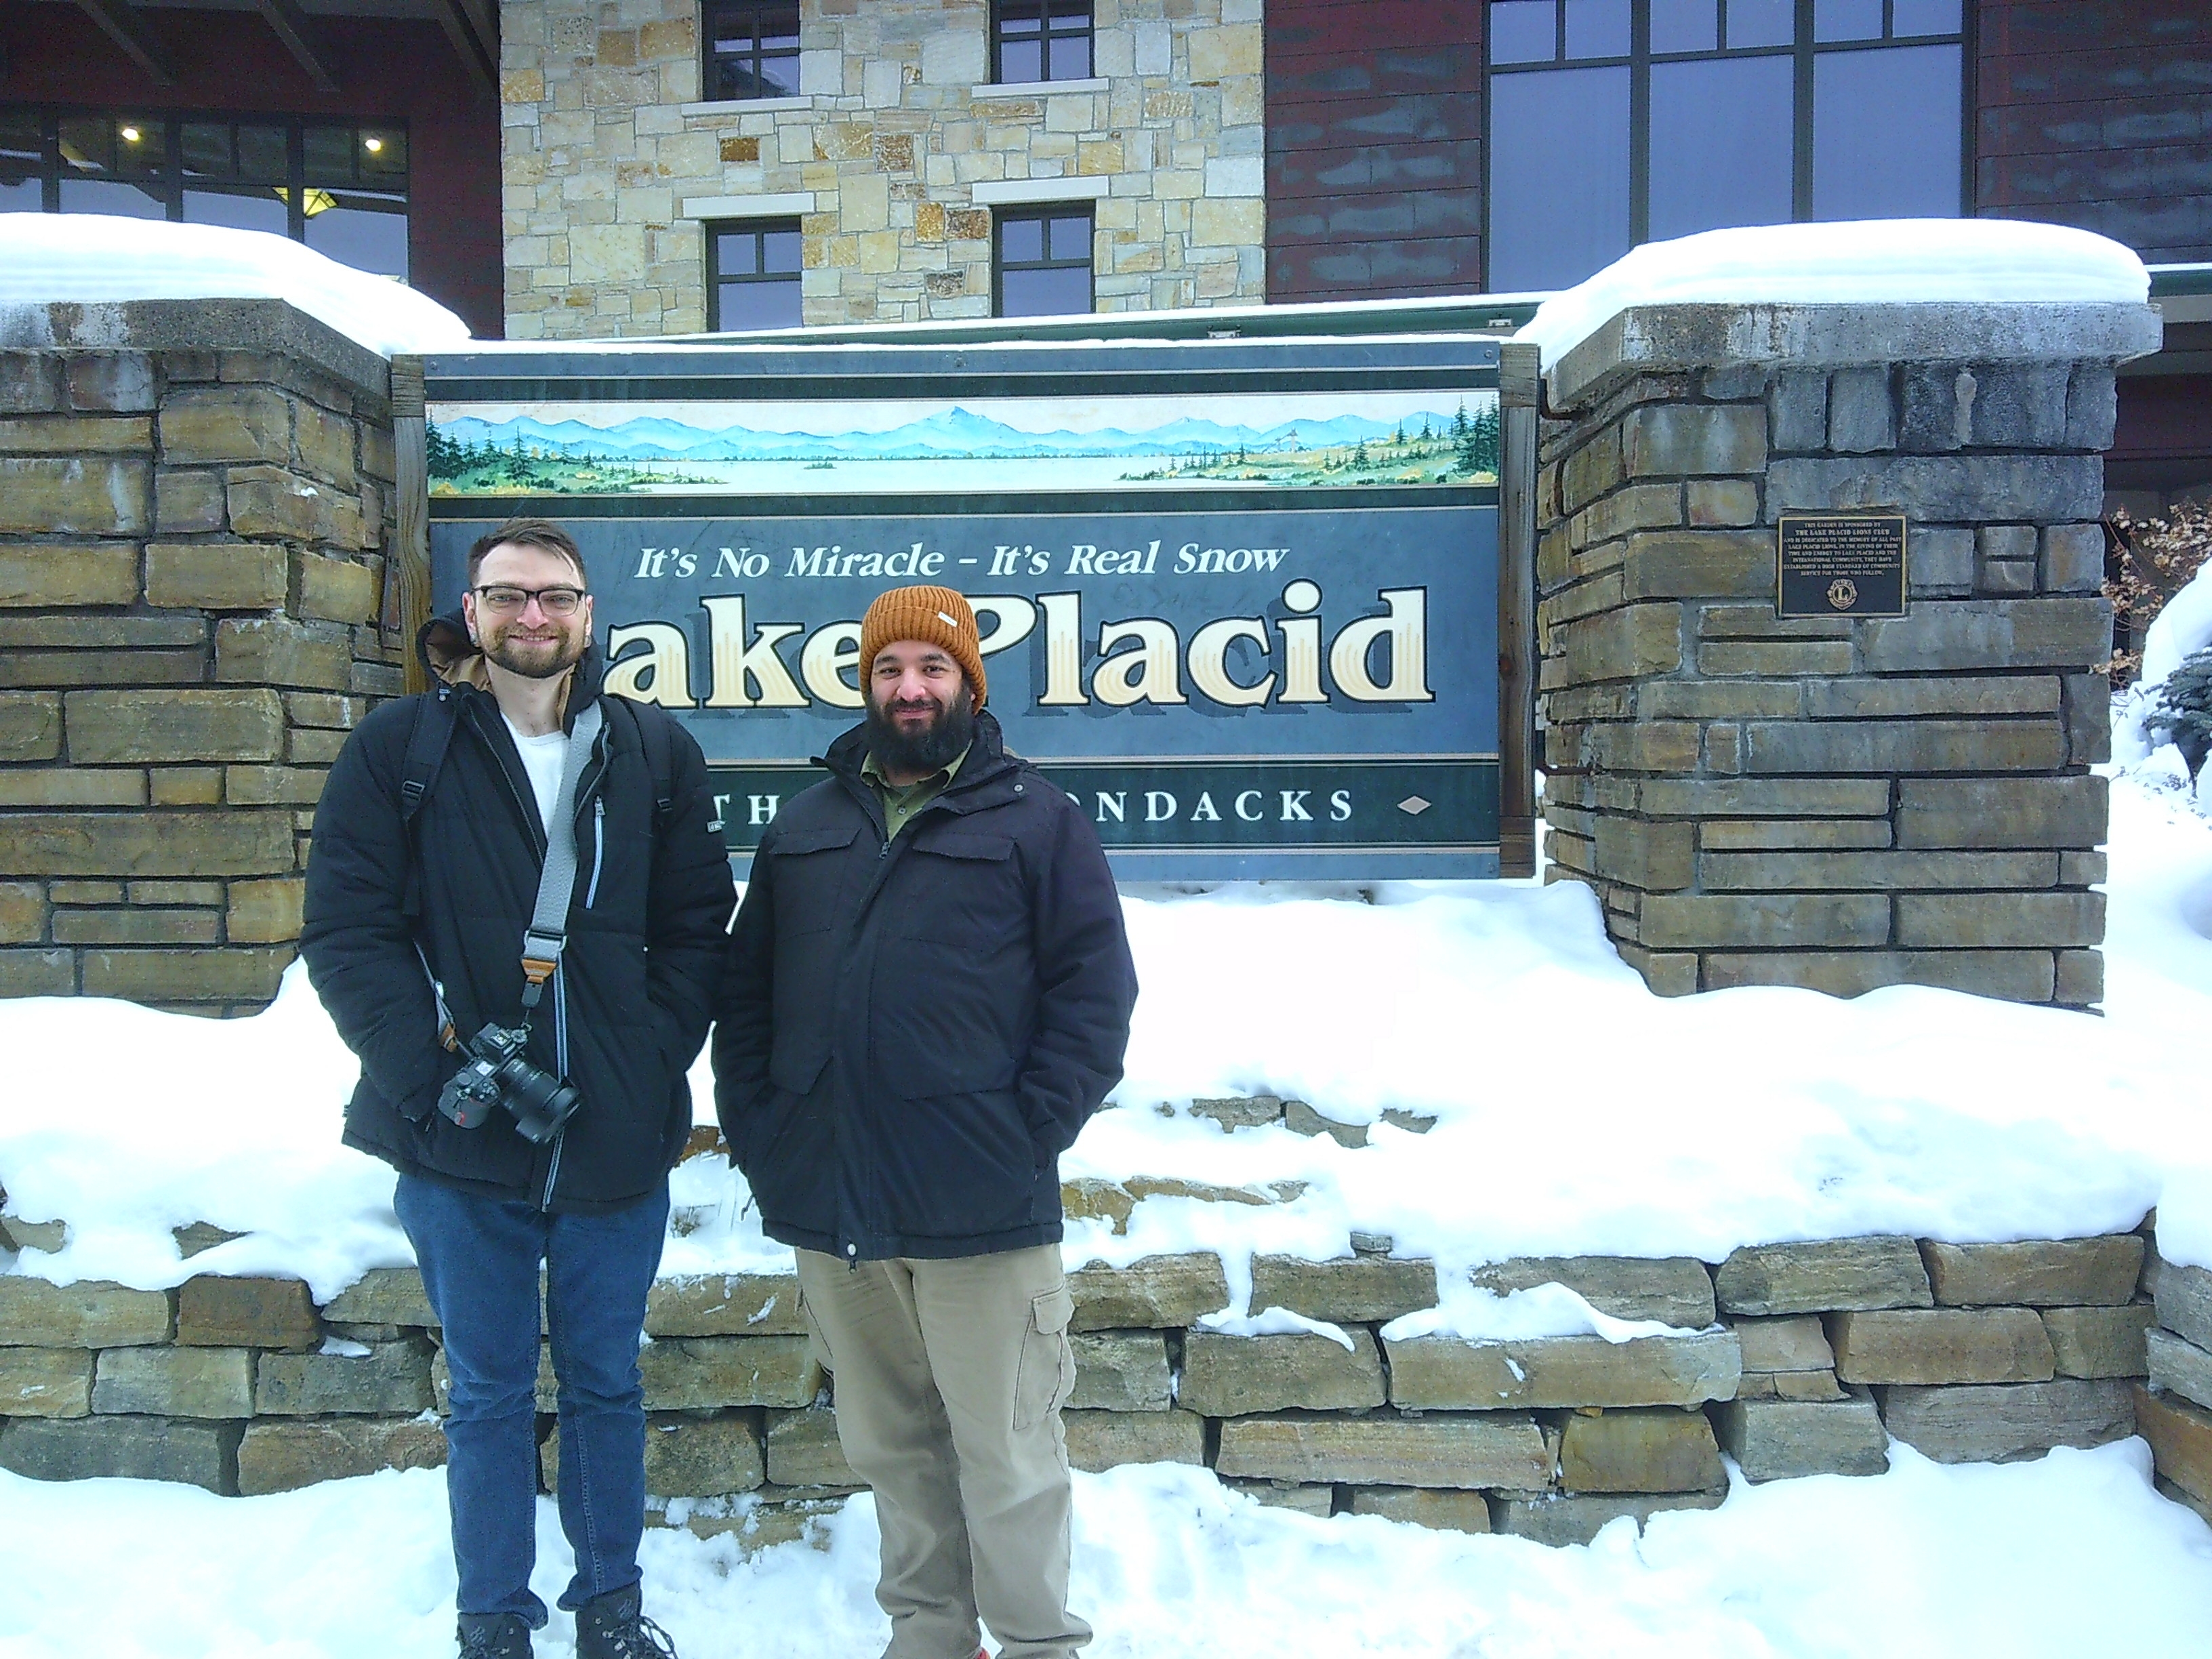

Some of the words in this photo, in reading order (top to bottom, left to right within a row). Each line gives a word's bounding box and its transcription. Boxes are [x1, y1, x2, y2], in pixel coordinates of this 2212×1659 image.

[634, 546, 697, 579] It's
[711, 546, 770, 579] No
[783, 541, 946, 578] Miracle
[986, 544, 1050, 577] It's
[1063, 539, 1162, 575] Real
[1173, 542, 1290, 575] Snow
[1838, 587, 1848, 600] L
[603, 593, 862, 710] ake
[713, 794, 780, 825] TH
[1065, 790, 1353, 822] NDACKS
